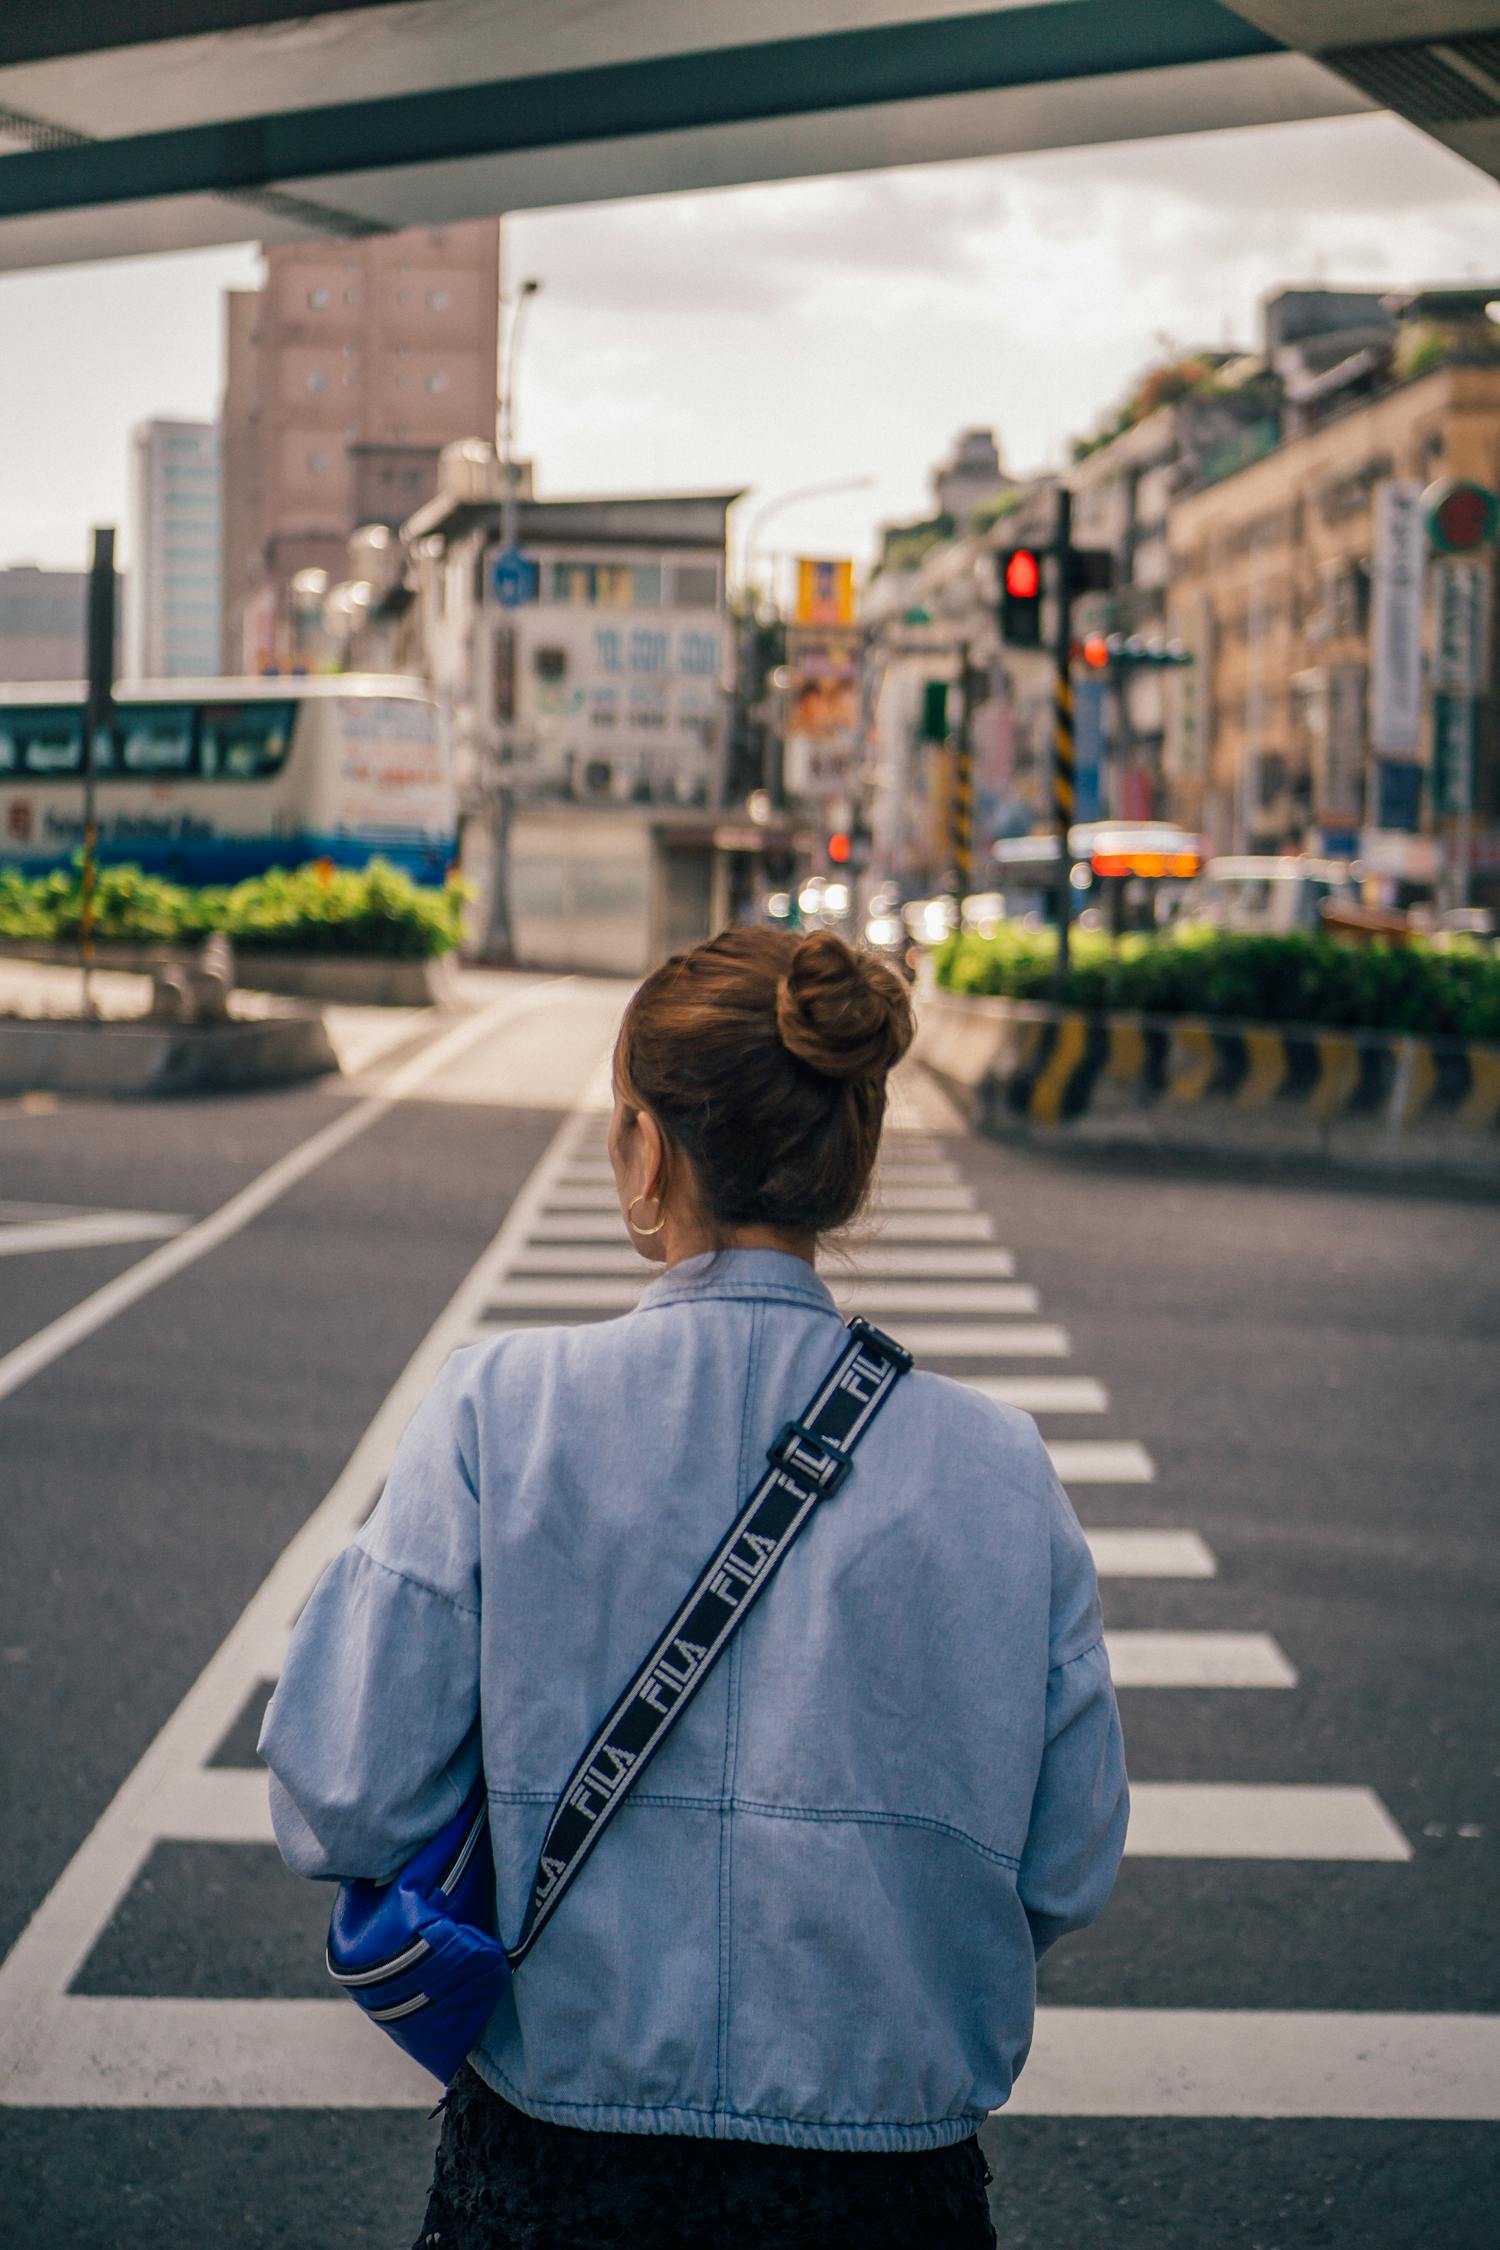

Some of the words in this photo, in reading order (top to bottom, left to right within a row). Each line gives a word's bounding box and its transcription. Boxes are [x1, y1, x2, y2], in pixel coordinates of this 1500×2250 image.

[839, 1354, 892, 1403] FIL
[709, 1531, 777, 1607] FILA
[639, 1638, 707, 1714] FILA
[569, 1743, 637, 1821] FILA
